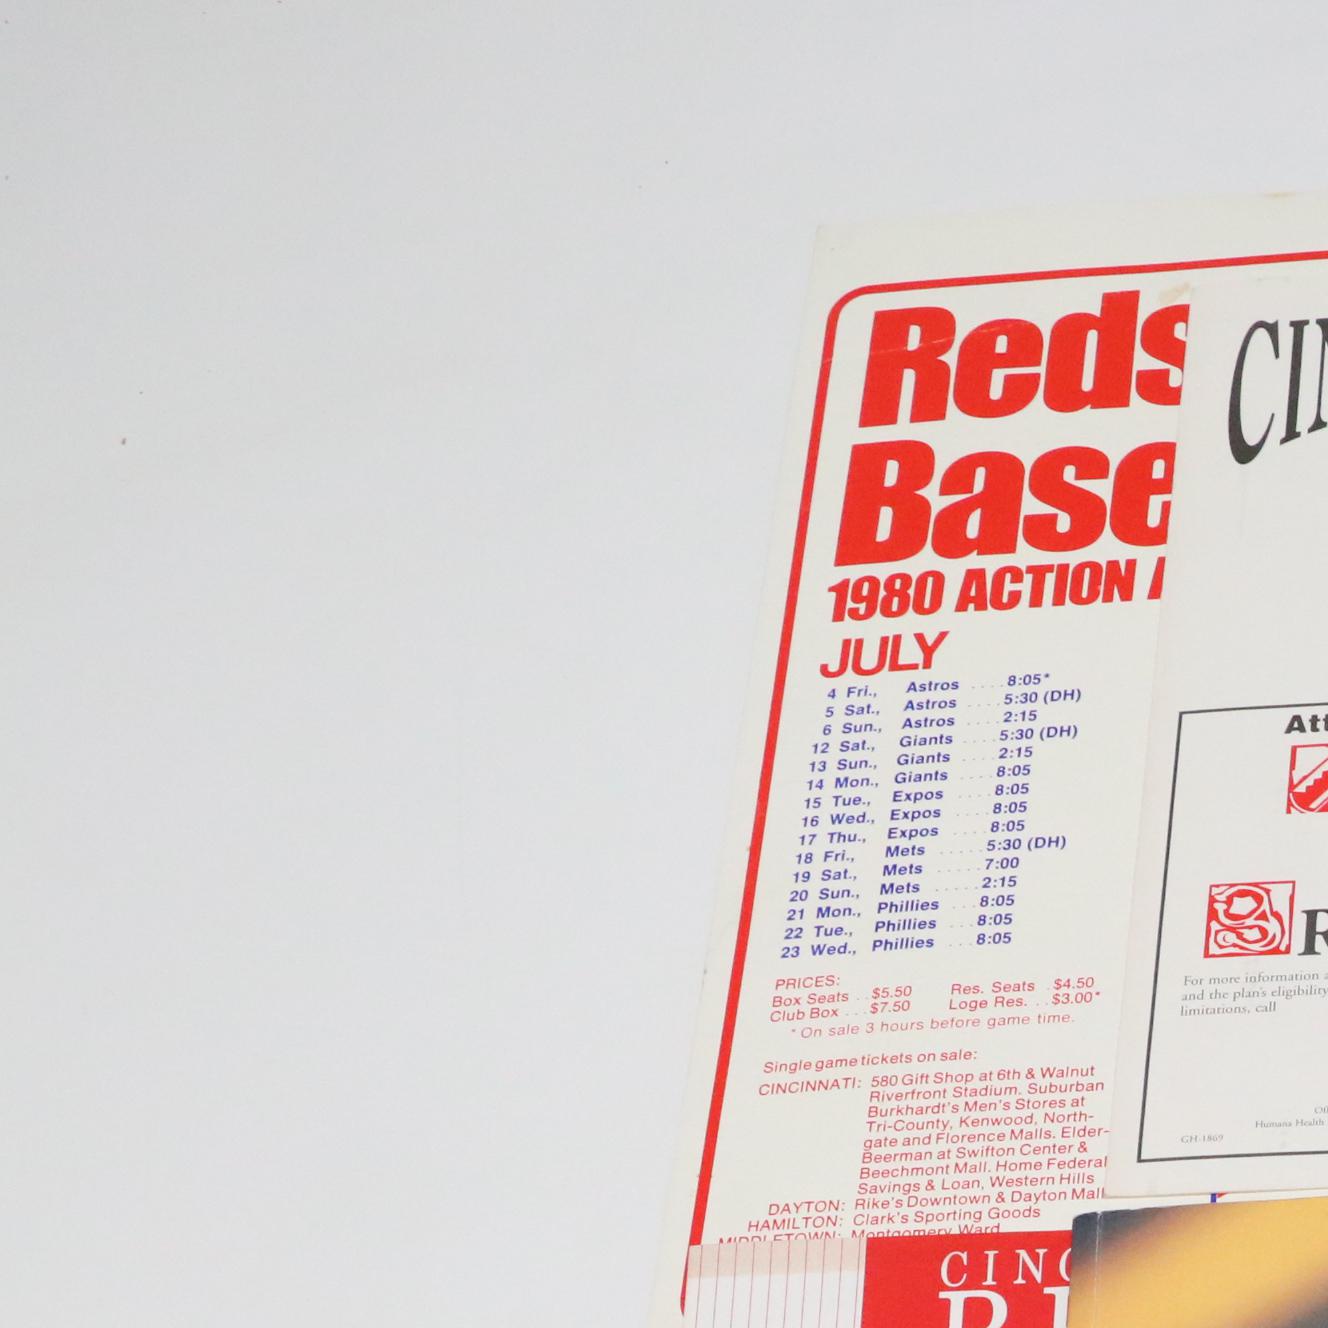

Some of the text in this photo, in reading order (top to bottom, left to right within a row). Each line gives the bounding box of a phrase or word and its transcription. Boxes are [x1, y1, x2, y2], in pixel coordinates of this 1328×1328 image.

[859, 290, 1190, 428] Reds
[834, 440, 1176, 567] Base
[828, 559, 1137, 622] 1980 ACTION
[820, 631, 949, 678] JULY
[828, 689, 836, 699] 4
[847, 685, 876, 698] Fri.,
[906, 681, 959, 693] Astros
[781, 932, 1011, 958] 23 Wed., Phillies 8:05
[776, 975, 839, 990] PRICES:
[1184, 976, 1203, 986] For
[1246, 972, 1319, 983] information
[773, 986, 912, 1007] Box Seats $5.50
[1181, 1001, 1276, 1016] limitations, call
[759, 1066, 1095, 1095] CINCINNATI: 580 Gift Shop at 6th & Walnut
